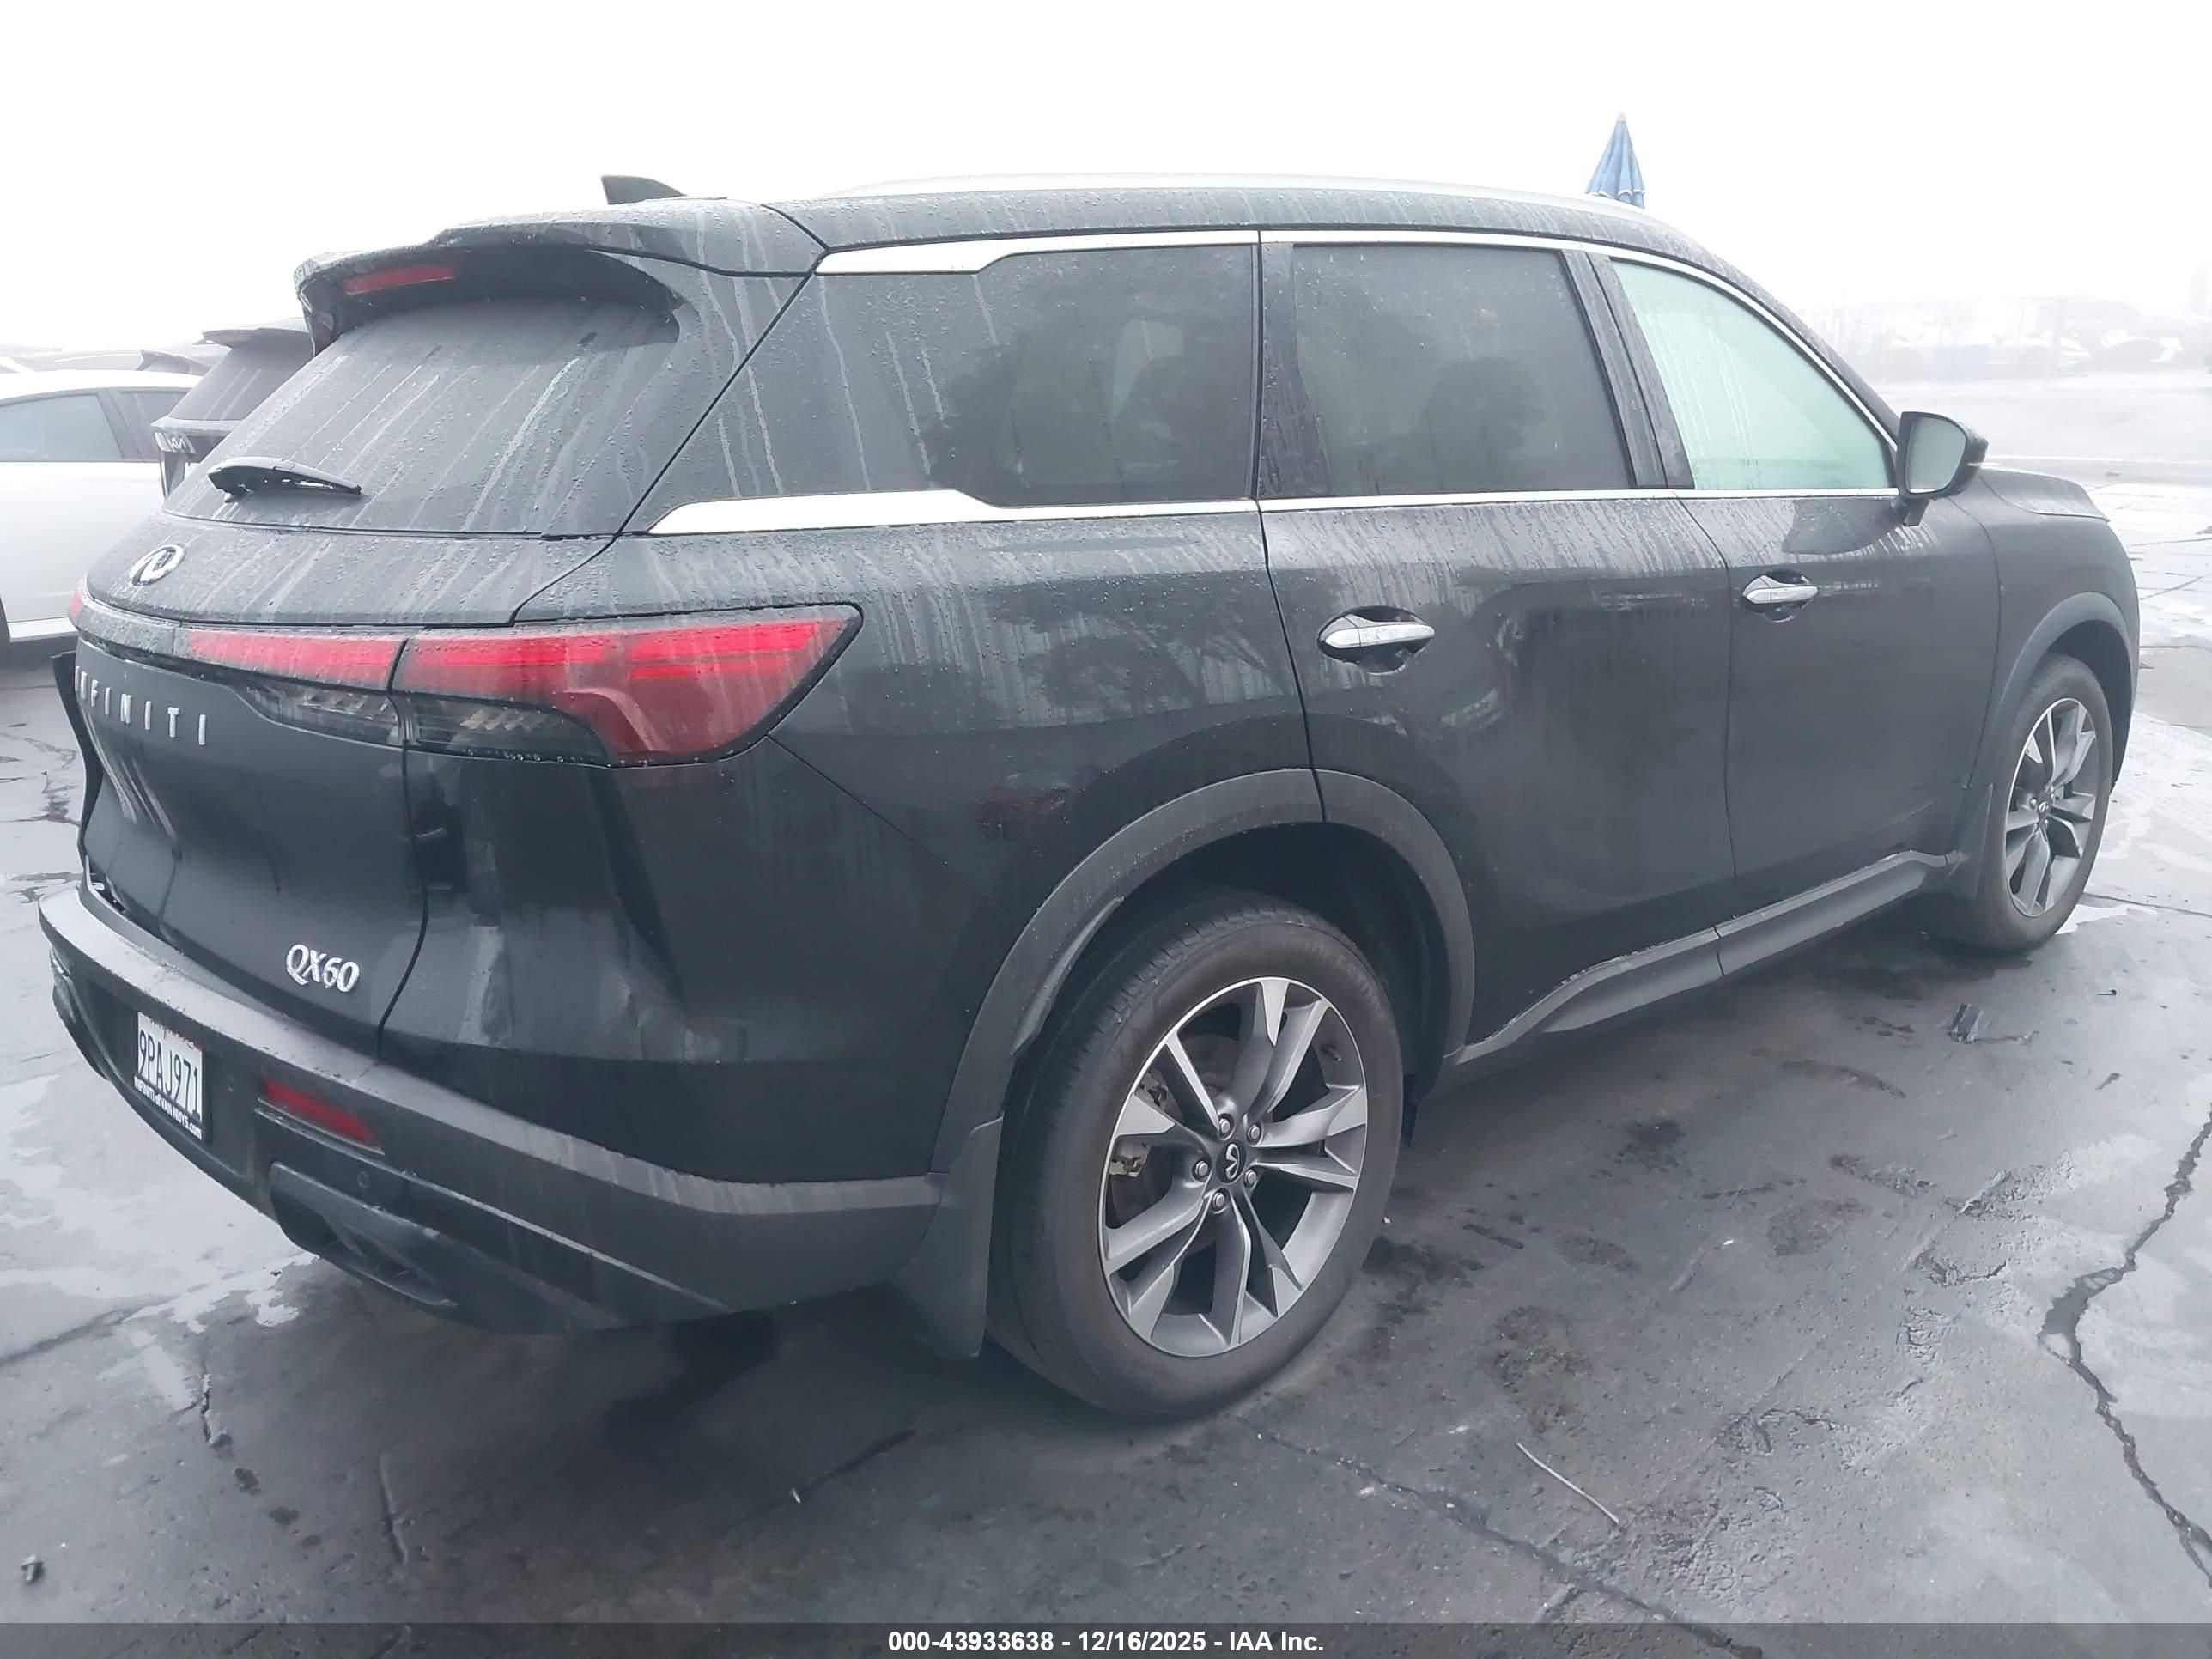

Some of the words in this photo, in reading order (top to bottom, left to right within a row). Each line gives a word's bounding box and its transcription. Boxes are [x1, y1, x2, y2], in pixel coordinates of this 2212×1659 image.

[286, 944, 360, 993] QX60
[133, 1075, 155, 1103] INFINITI
[161, 1097, 173, 1117] VAN
[139, 1029, 198, 1114] 9PAJ971
